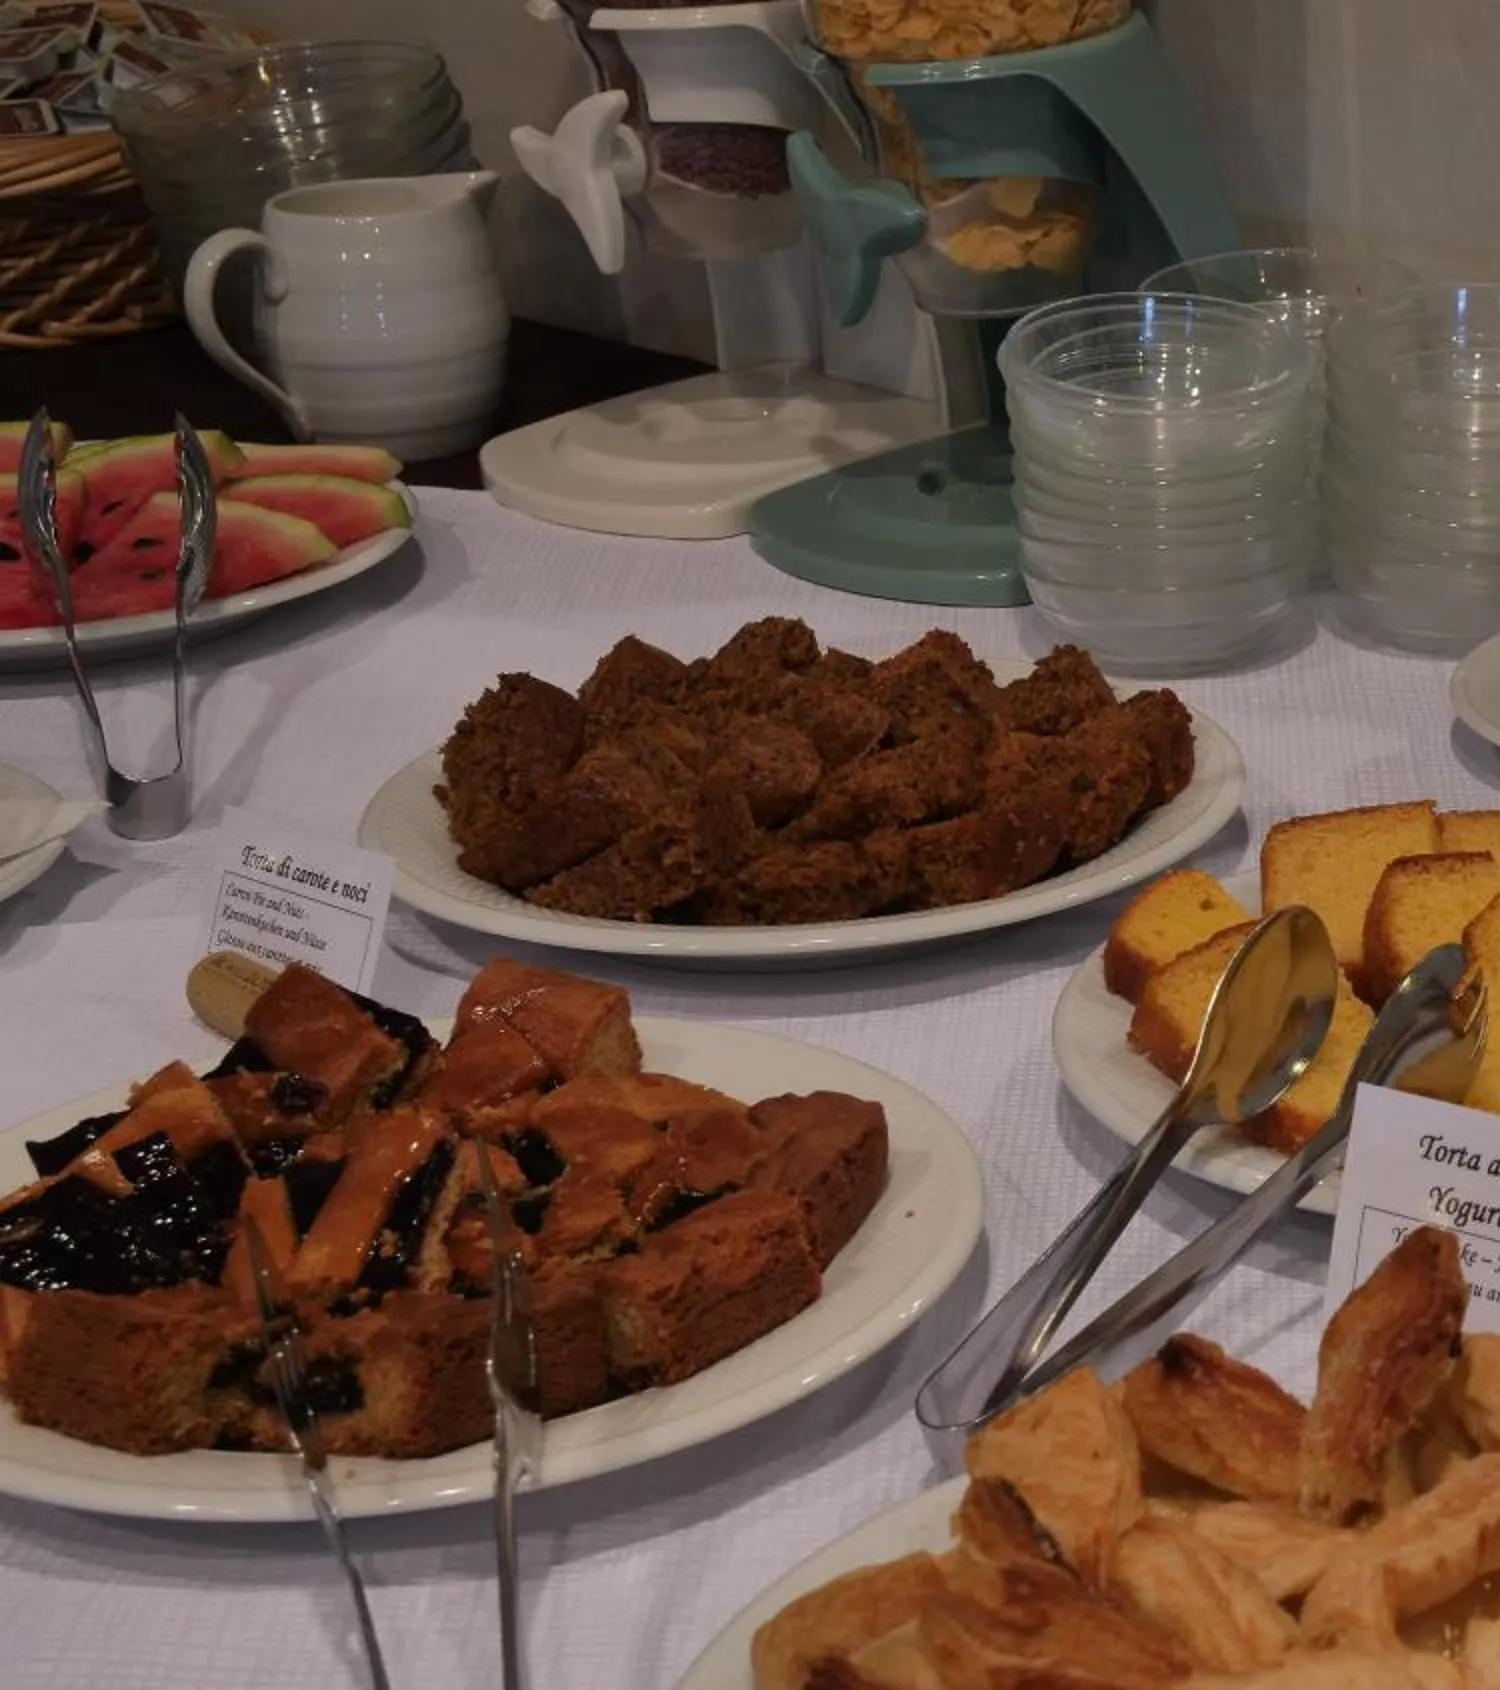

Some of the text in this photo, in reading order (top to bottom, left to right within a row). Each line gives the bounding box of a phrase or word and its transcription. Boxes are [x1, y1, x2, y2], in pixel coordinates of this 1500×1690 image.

[291, 866, 331, 891] carote
[331, 879, 340, 894] e
[1419, 1134, 1481, 1172] Torta
